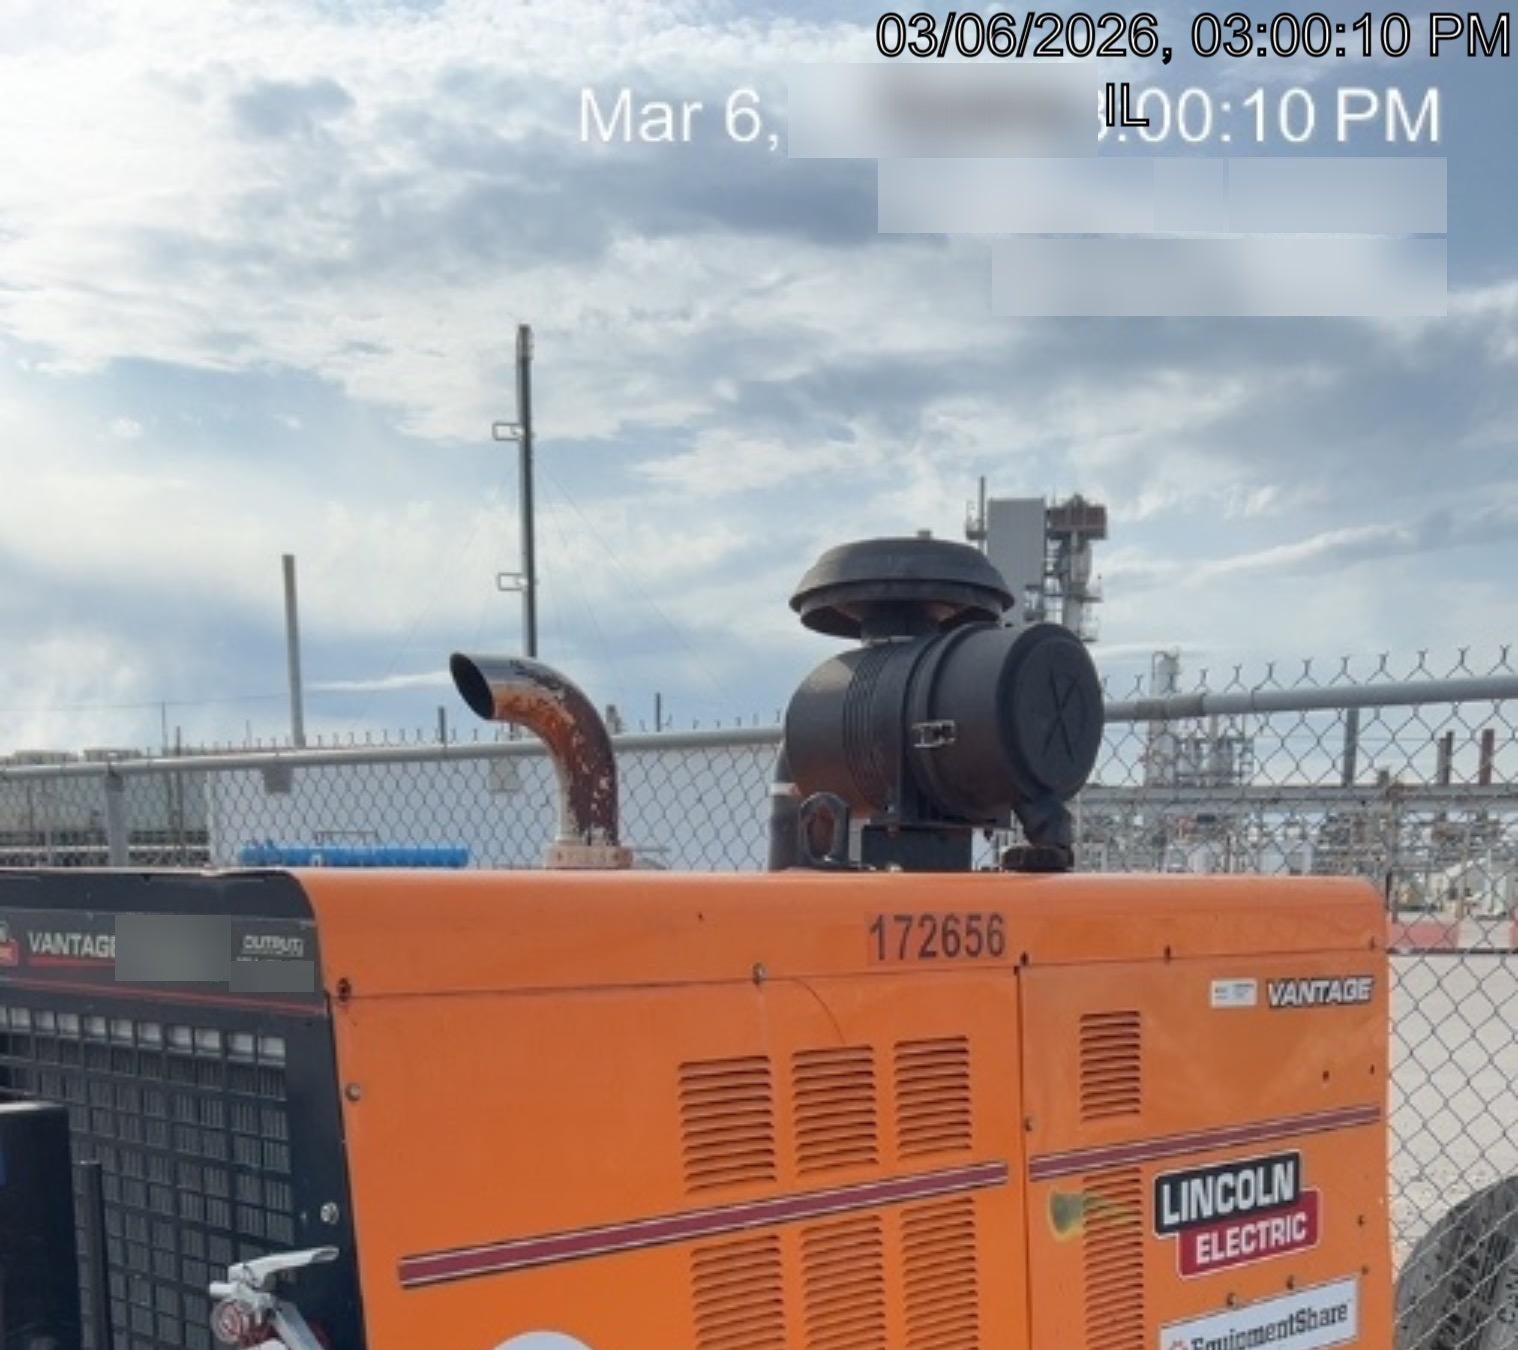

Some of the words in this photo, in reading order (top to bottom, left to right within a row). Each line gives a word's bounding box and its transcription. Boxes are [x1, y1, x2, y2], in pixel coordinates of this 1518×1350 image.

[869, 913, 1006, 961] 172656
[1268, 977, 1373, 1006] VANTAGE
[1161, 1160, 1295, 1227] LINCOLN
[1195, 1213, 1307, 1264] ELECTRIC
